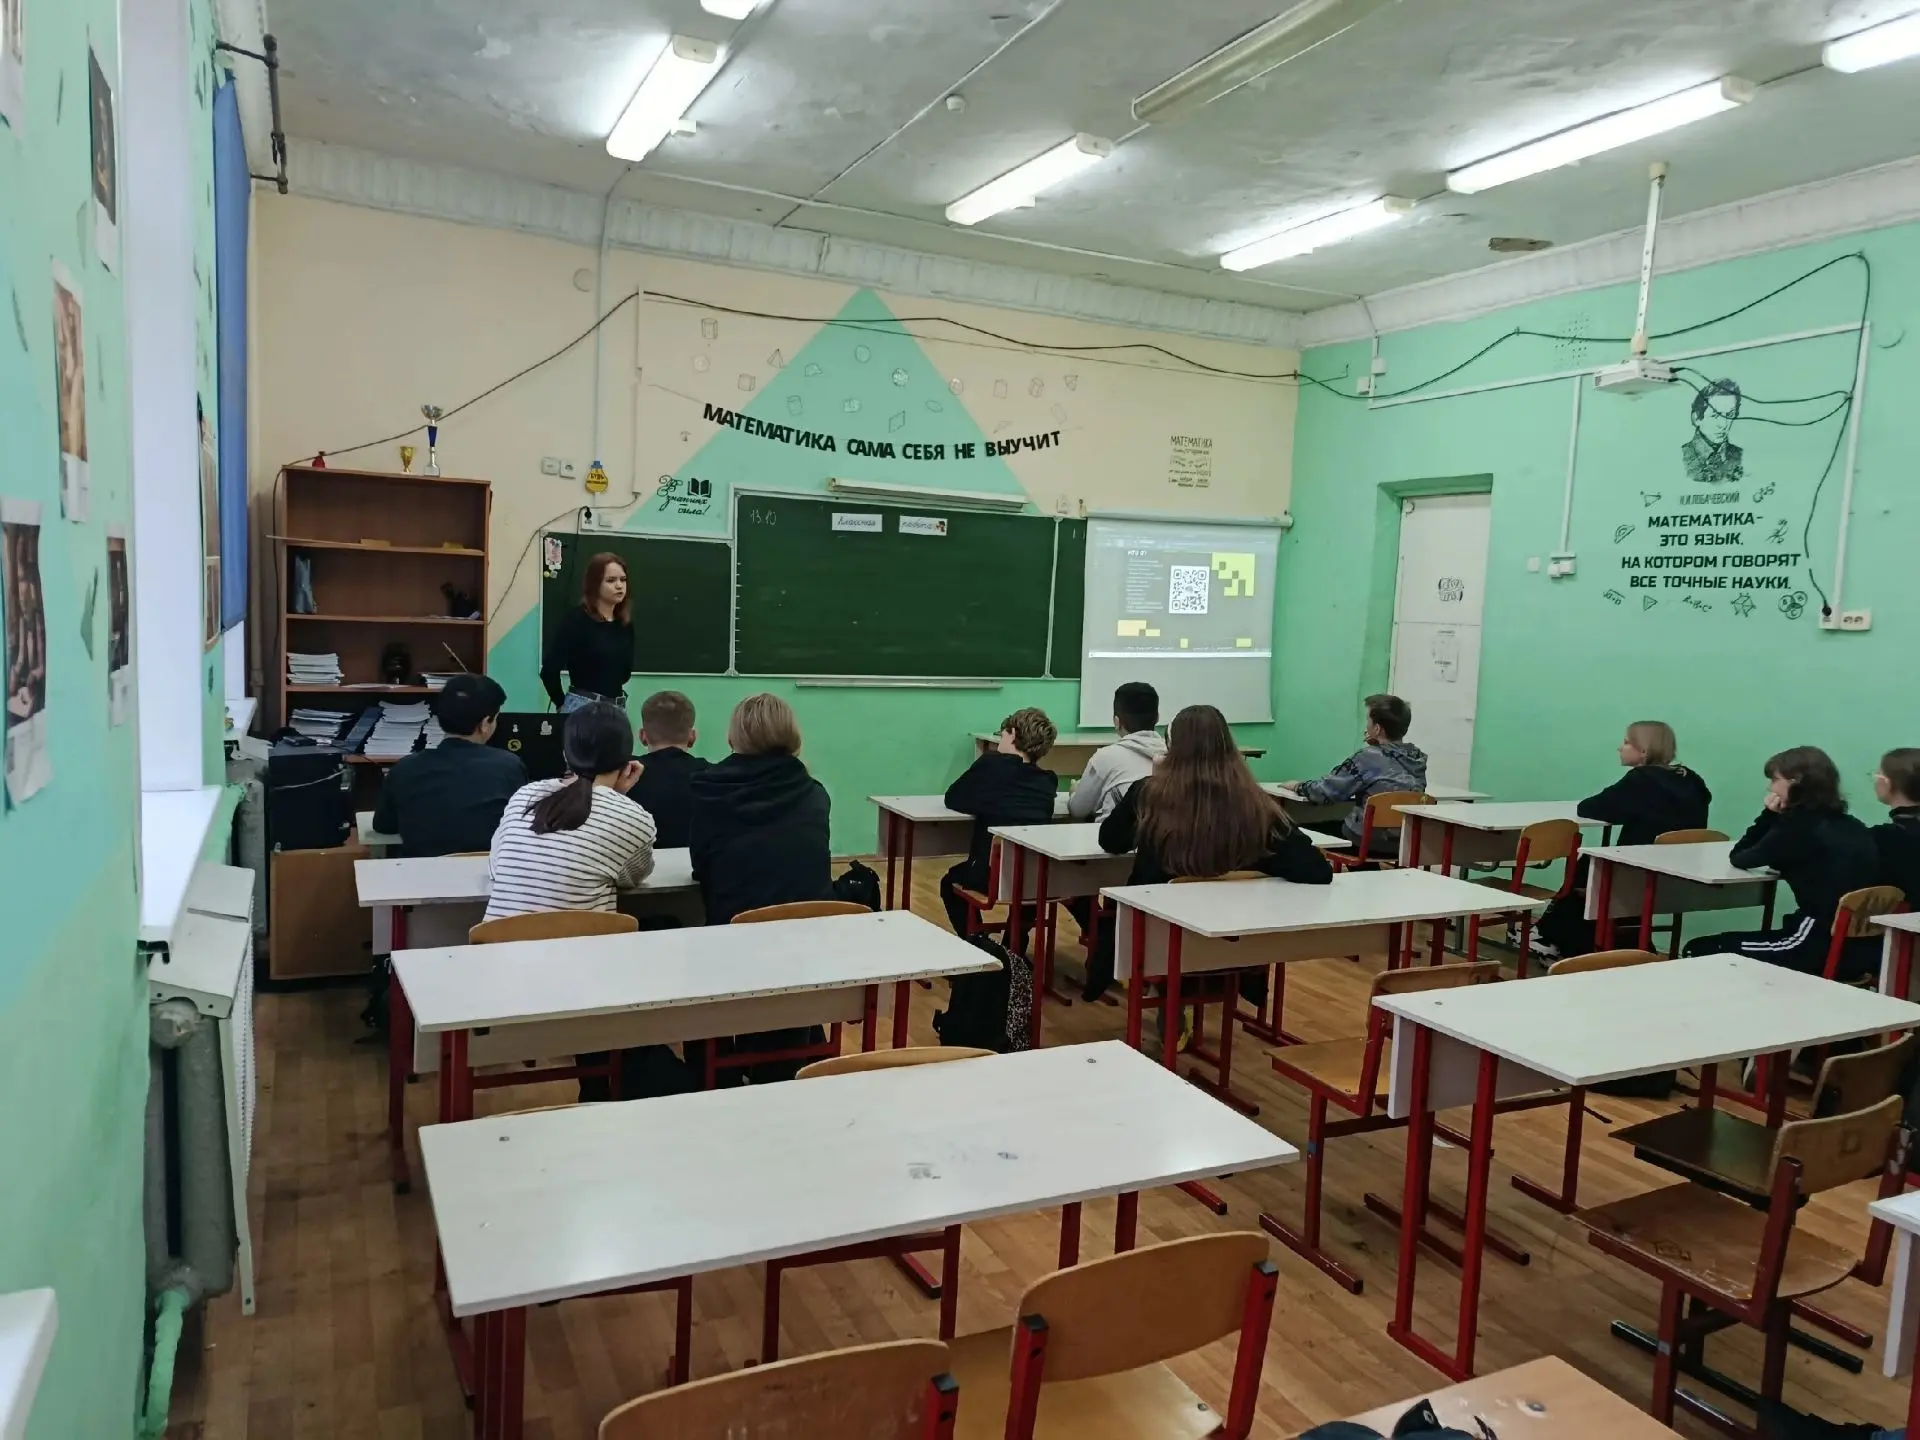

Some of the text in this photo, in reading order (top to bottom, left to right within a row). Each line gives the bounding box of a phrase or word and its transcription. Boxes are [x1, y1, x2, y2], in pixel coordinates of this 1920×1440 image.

[703, 403, 1062, 460] МАТЕМАТИКА САМА СЕБЯ НЕ ВЫУЧИТ
[1659, 534, 1688, 546] ЭТО
[1621, 554, 1801, 569] НА КОТОРОМ ГОВОРЯТ
[1630, 575, 1792, 590] ВСЕ ТОЧНЫЕ НАУКИ.
